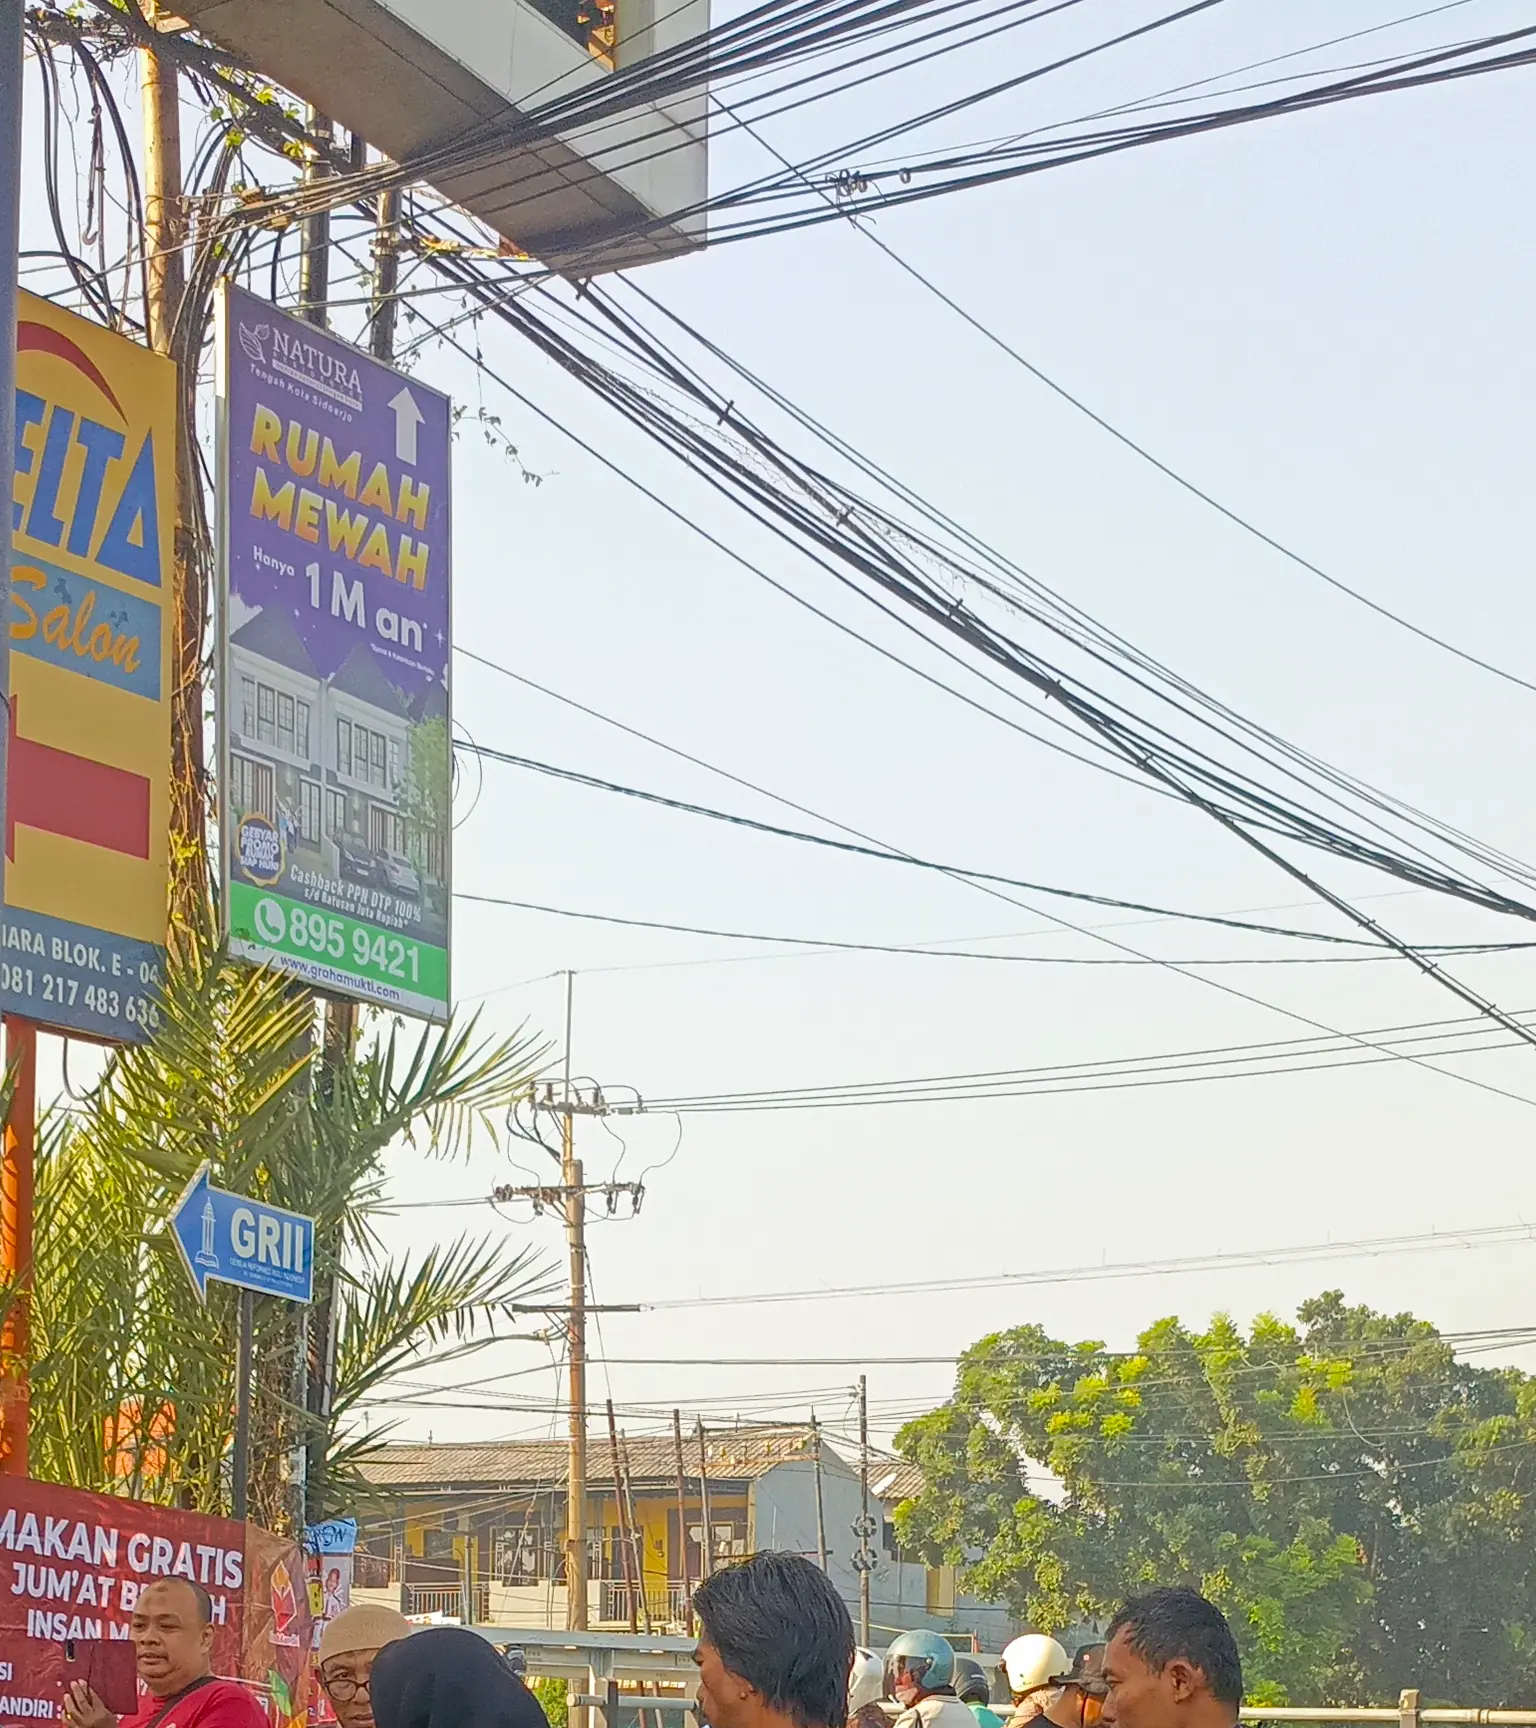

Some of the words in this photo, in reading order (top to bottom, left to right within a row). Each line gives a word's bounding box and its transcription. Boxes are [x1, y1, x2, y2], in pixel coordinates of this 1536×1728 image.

[250, 363, 285, 389] Tengah
[287, 382, 310, 401] Kota
[312, 395, 353, 423] Sidoarjo
[272, 327, 363, 395] NATURA
[249, 403, 430, 532] RUMAH
[249, 466, 430, 591] MEWAH
[9, 564, 142, 674] Salon
[252, 545, 296, 578] Hanya
[305, 562, 320, 608] 1
[330, 570, 366, 629] M
[241, 837, 279, 854] PROMO
[290, 863, 344, 897] Cashback
[347, 882, 367, 906] PPN
[371, 891, 392, 912] DTP
[395, 900, 422, 924] 100%
[304, 887, 320, 902] s/d
[321, 892, 355, 914] Ratusan
[356, 902, 375, 920] Juta
[51, 936, 106, 972] BLOK.
[111, 952, 122, 976] E
[279, 955, 401, 1000] www.grahamukti.com
[289, 908, 345, 959] 895
[352, 927, 420, 983] 9421
[1, 962, 33, 997] 081
[42, 973, 79, 1007] 217
[84, 984, 120, 1018] 483
[125, 995, 160, 1029] 636
[230, 1207, 304, 1274] GRII
[127, 1532, 244, 1589] GRATIS
[26, 1608, 103, 1641] INSAN
